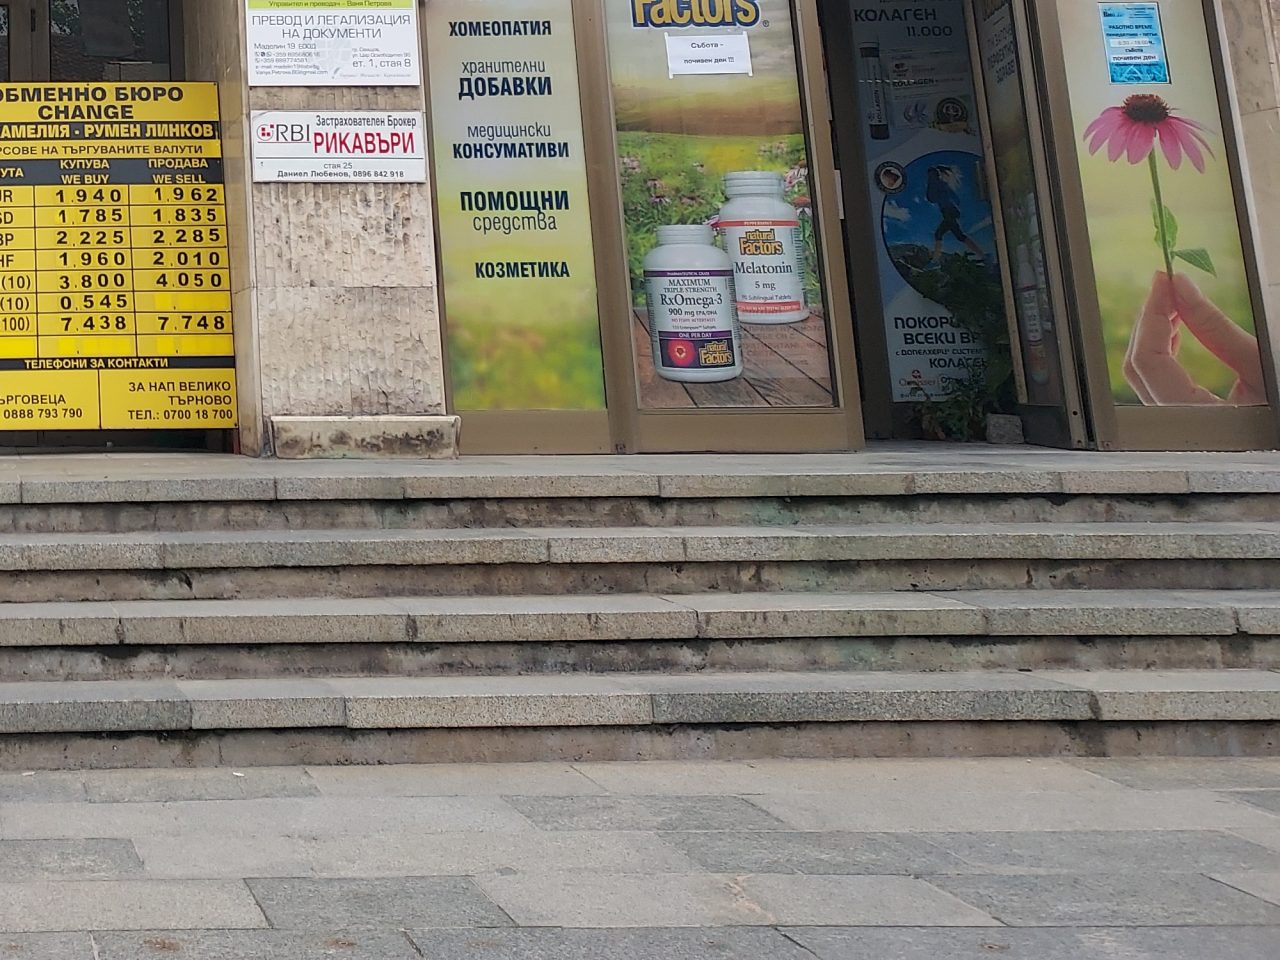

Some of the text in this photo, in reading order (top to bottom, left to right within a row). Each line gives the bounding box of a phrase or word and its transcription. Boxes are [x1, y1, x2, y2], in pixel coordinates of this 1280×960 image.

[252, 14, 411, 28] ПРЕВОД И ЛЕГАЛИЗАЦИЯ
[854, 8, 937, 22] КОЛАГЕН
[282, 28, 382, 40] НА ДОКУМЕНТИ
[449, 20, 552, 37] ХОМЕОПАТИЯ
[379, 60, 402, 68] стая
[462, 60, 546, 77] хранителни
[114, 86, 184, 102] БЮРО
[458, 77, 553, 100] ДОБАВКИ
[37, 104, 134, 120] CHANGE
[316, 114, 417, 129] Застрахователен Брокер
[84, 123, 141, 138] РУМЕН
[145, 123, 214, 138] ЛИНКОВ
[276, 124, 310, 142] RBI
[467, 121, 552, 141] медицински
[41, 145, 58, 155] НА
[61, 145, 150, 155] ТЪРГУВАНИТЕ
[153, 144, 203, 154] ВАЛУТИ
[314, 132, 415, 154] РИКАВЪРИ
[453, 142, 569, 159] КОНСУМАТИВИ
[60, 159, 109, 169] КУПУВА
[148, 158, 208, 170] ПРОДАВА
[61, 174, 109, 184] WE BUY
[152, 174, 206, 184] WE SELL
[277, 170, 308, 178] Даниел
[353, 170, 372, 178] 0896
[373, 170, 388, 178] 842
[390, 170, 404, 178] 918
[460, 190, 570, 214] ПОМОЩНИ
[473, 212, 558, 235] средства
[740, 237, 783, 255] Factors
[475, 261, 571, 279] КОЗМЕТИКА
[735, 261, 792, 274] Melatonin
[668, 278, 711, 287] MAXIMUM
[755, 281, 776, 291] 5 mg
[660, 293, 723, 308] RxOmega-3
[668, 308, 695, 318] 900 mg
[24, 358, 168, 369] ТЕЛЕФОНИ ЗА КОНТАКТИ
[700, 348, 733, 365] Factors
[129, 381, 231, 392] ЗА НАП ВЕЛИКО
[169, 395, 232, 406] ТЪРНОВО
[3, 409, 33, 419] 0888
[36, 408, 58, 419] 793
[62, 408, 83, 418] 790
[128, 409, 233, 420] ТЕЛ.: 0700 18 700
